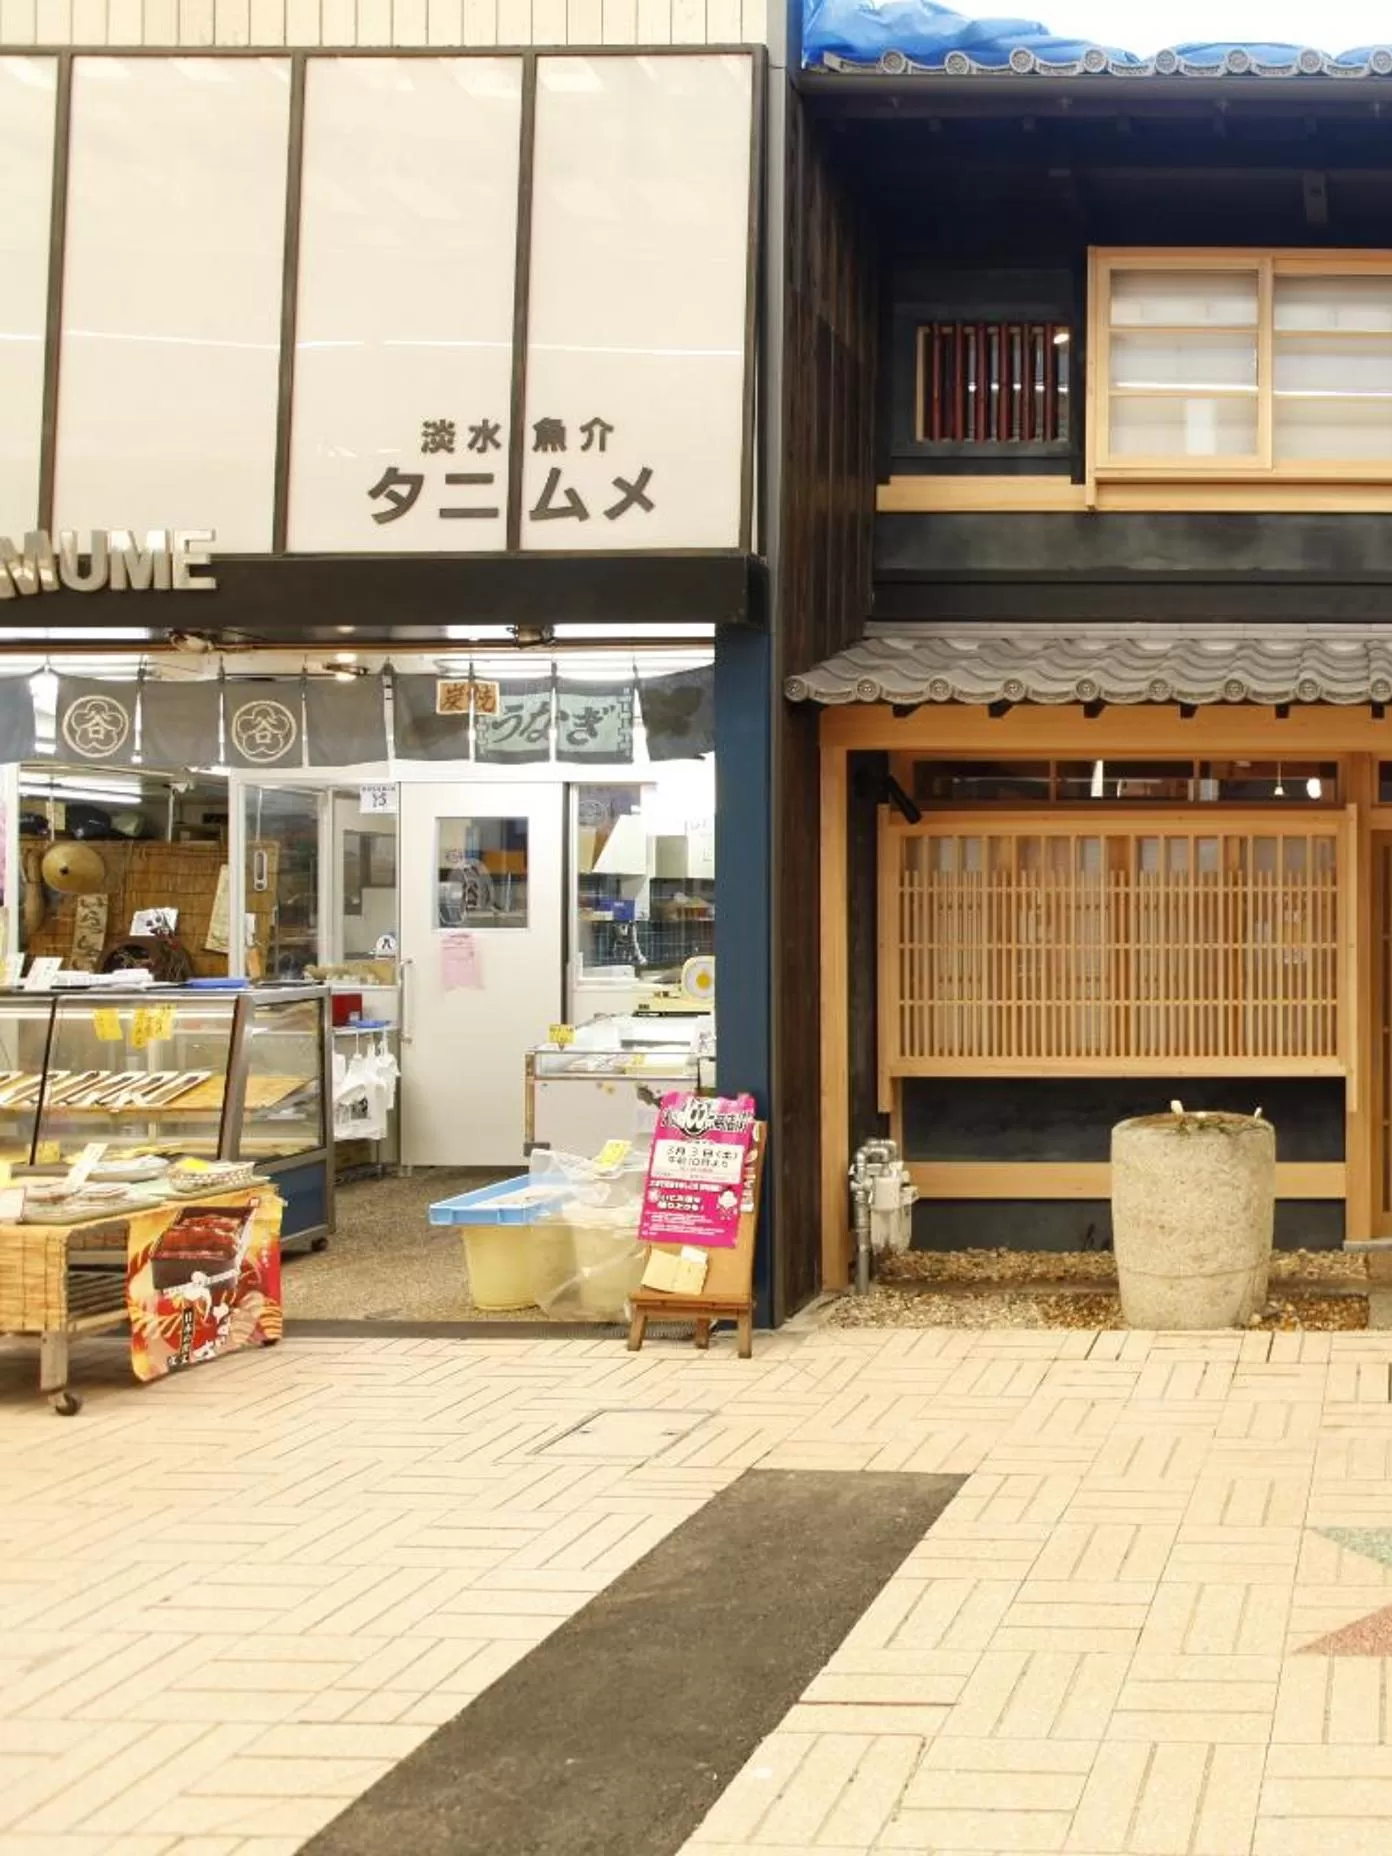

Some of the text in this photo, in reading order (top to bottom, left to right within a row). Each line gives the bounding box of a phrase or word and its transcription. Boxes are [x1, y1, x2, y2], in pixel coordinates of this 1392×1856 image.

[421, 417, 614, 454] 淡水魚介
[368, 466, 656, 524] タニムメ
[0, 529, 217, 599] MUME
[491, 700, 617, 746] うなぎ
